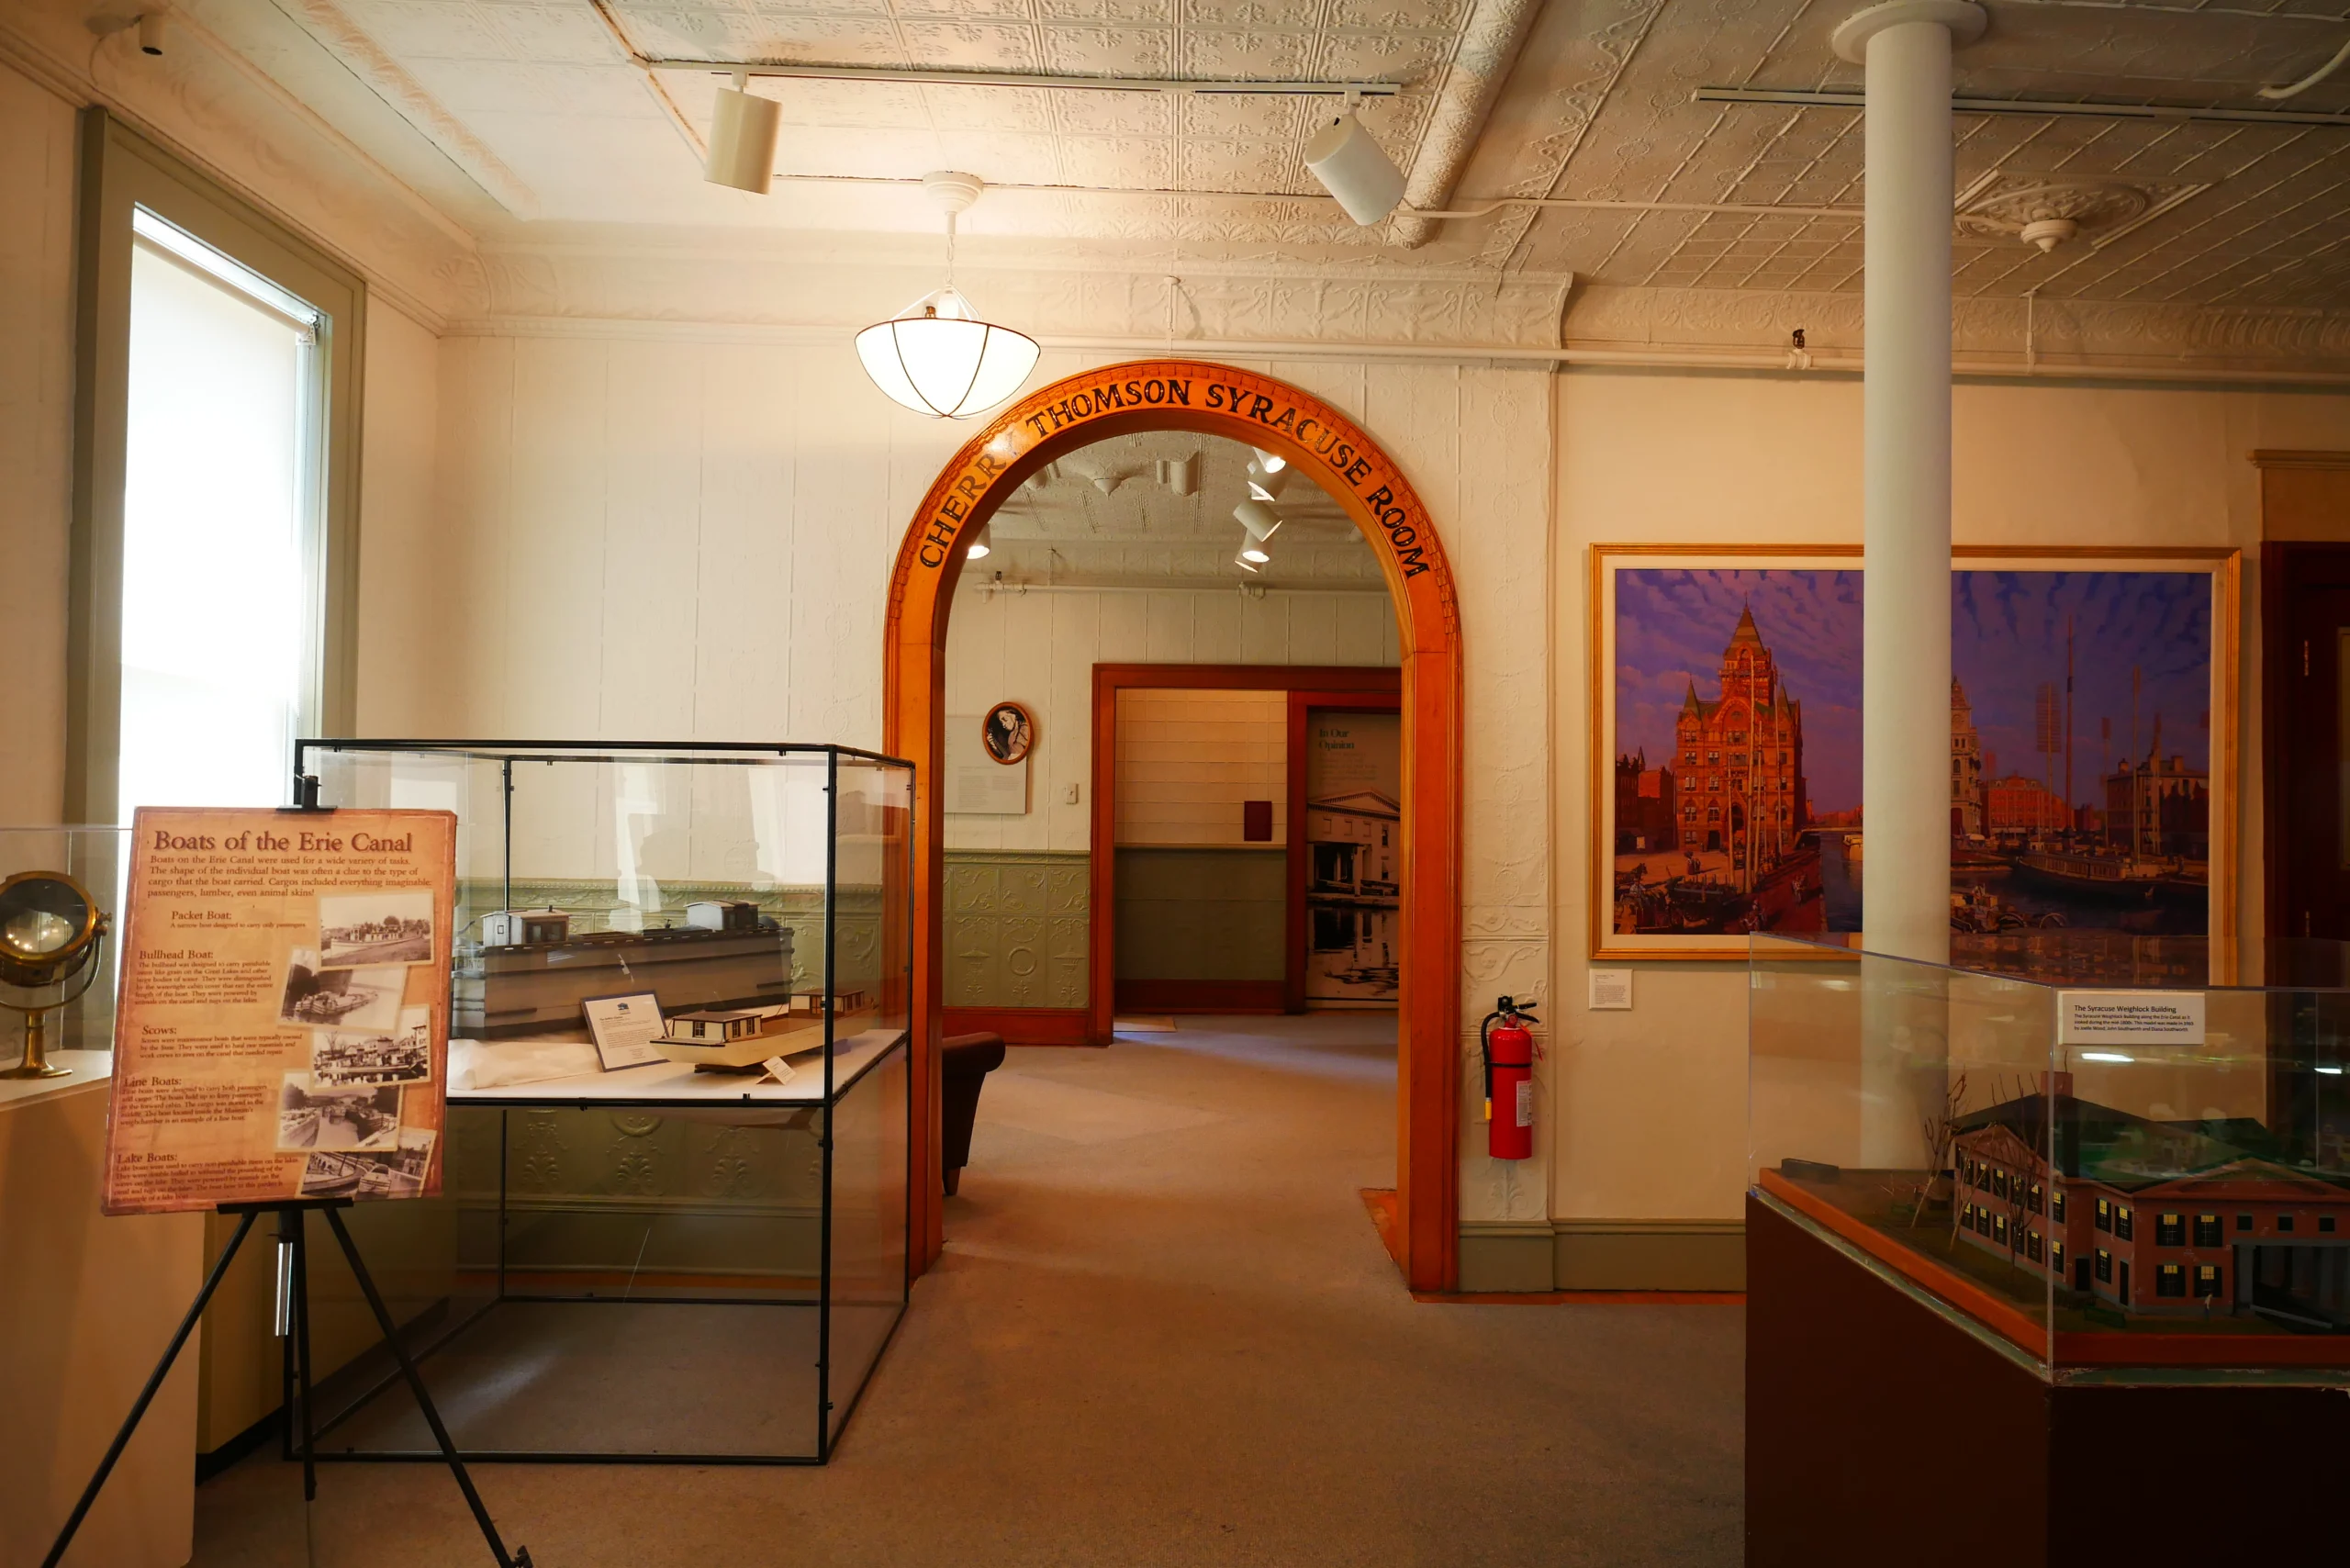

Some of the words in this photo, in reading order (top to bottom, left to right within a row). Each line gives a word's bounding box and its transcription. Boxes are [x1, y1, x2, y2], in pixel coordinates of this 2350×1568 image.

[919, 431, 1023, 568] CHERR
[1026, 379, 1192, 439] THOMSON
[1206, 384, 1372, 487] SYRACUSE
[1366, 486, 1429, 578] ROOM
[1319, 729, 1328, 737] In
[1331, 729, 1349, 737] Our
[1319, 740, 1354, 751] Opinion
[153, 830, 216, 850] Boats
[224, 830, 252, 850] of
[256, 830, 290, 850] the
[298, 832, 343, 851] Erie
[351, 832, 412, 852] Canal
[151, 856, 174, 864] Boats
[192, 856, 206, 864] the
[209, 856, 227, 864] Erie
[229, 856, 254, 864] Canal
[281, 857, 300, 865] used
[349, 857, 375, 866] variety
[389, 857, 410, 865] tasks.
[150, 866, 167, 874] The
[170, 867, 195, 877] shape
[197, 866, 208, 874] of
[210, 867, 227, 875] the
[227, 867, 269, 875] individual
[271, 867, 290, 875] boat
[311, 867, 333, 875] often
[343, 867, 361, 875] clue
[389, 868, 407, 877] type
[148, 879, 173, 888] cargo
[175, 878, 193, 886] that
[196, 878, 208, 886] the
[211, 878, 231, 886] boat
[233, 878, 265, 886] carried.
[268, 879, 298, 888] Cargos
[301, 878, 337, 886] included
[340, 879, 383, 888] everything
[385, 879, 432, 888] imaginable:
[147, 890, 196, 898] passengers,
[200, 889, 234, 897] lumber,
[260, 889, 288, 897] animal
[291, 889, 315, 897] skins!
[171, 911, 203, 920] Packet
[207, 911, 232, 920] Boat:
[139, 950, 184, 959] Bullhead
[187, 950, 214, 959] Boat:
[2117, 1005, 2150, 1014] Weighlock
[142, 1025, 177, 1036] Scows:
[124, 1077, 147, 1087] Line
[151, 1076, 182, 1086] Boats:
[117, 1153, 142, 1164] Lake
[147, 1152, 178, 1163] Boats:
